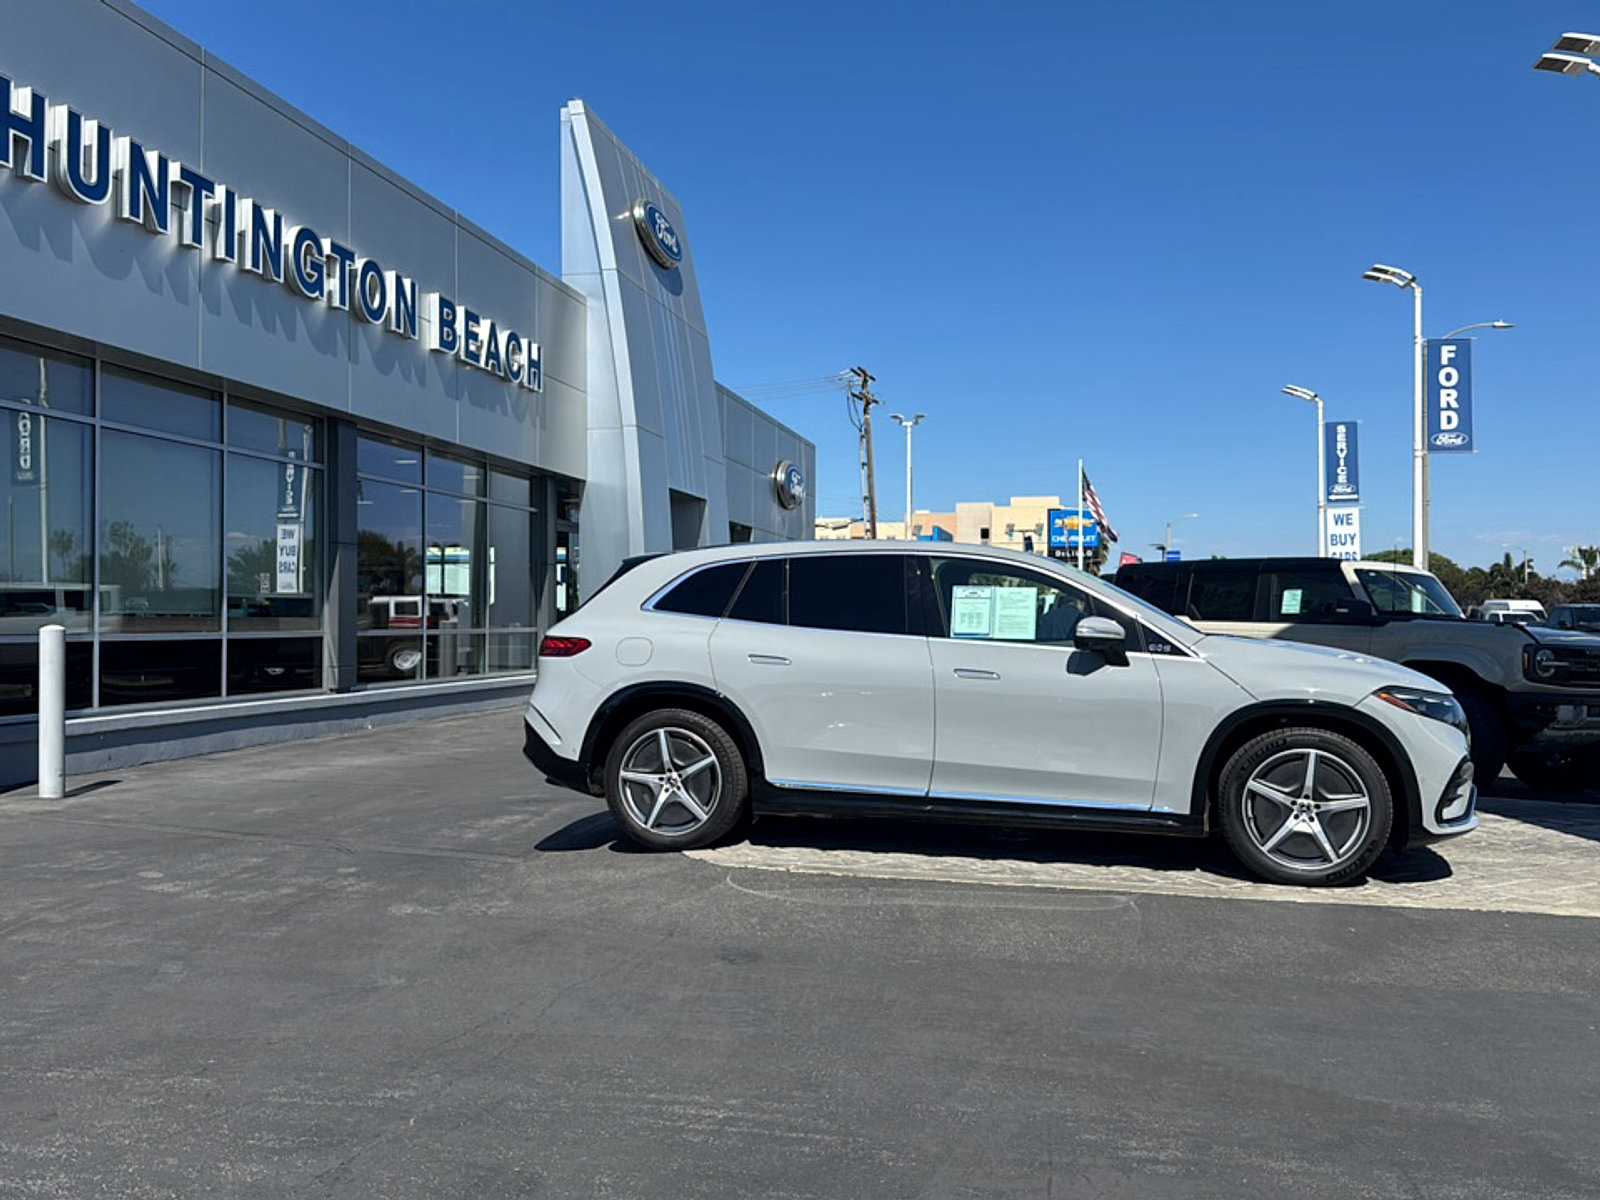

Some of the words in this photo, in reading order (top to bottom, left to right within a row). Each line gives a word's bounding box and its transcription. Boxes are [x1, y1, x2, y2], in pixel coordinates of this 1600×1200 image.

[0, 73, 418, 340] HUNTINGTON
[431, 292, 544, 392] BEACH
[655, 212, 678, 254] Ford
[1438, 344, 1460, 430] FORD
[1336, 424, 1348, 483] SERVICE
[1330, 534, 1356, 546] BUY
[1333, 514, 1353, 526] WE
